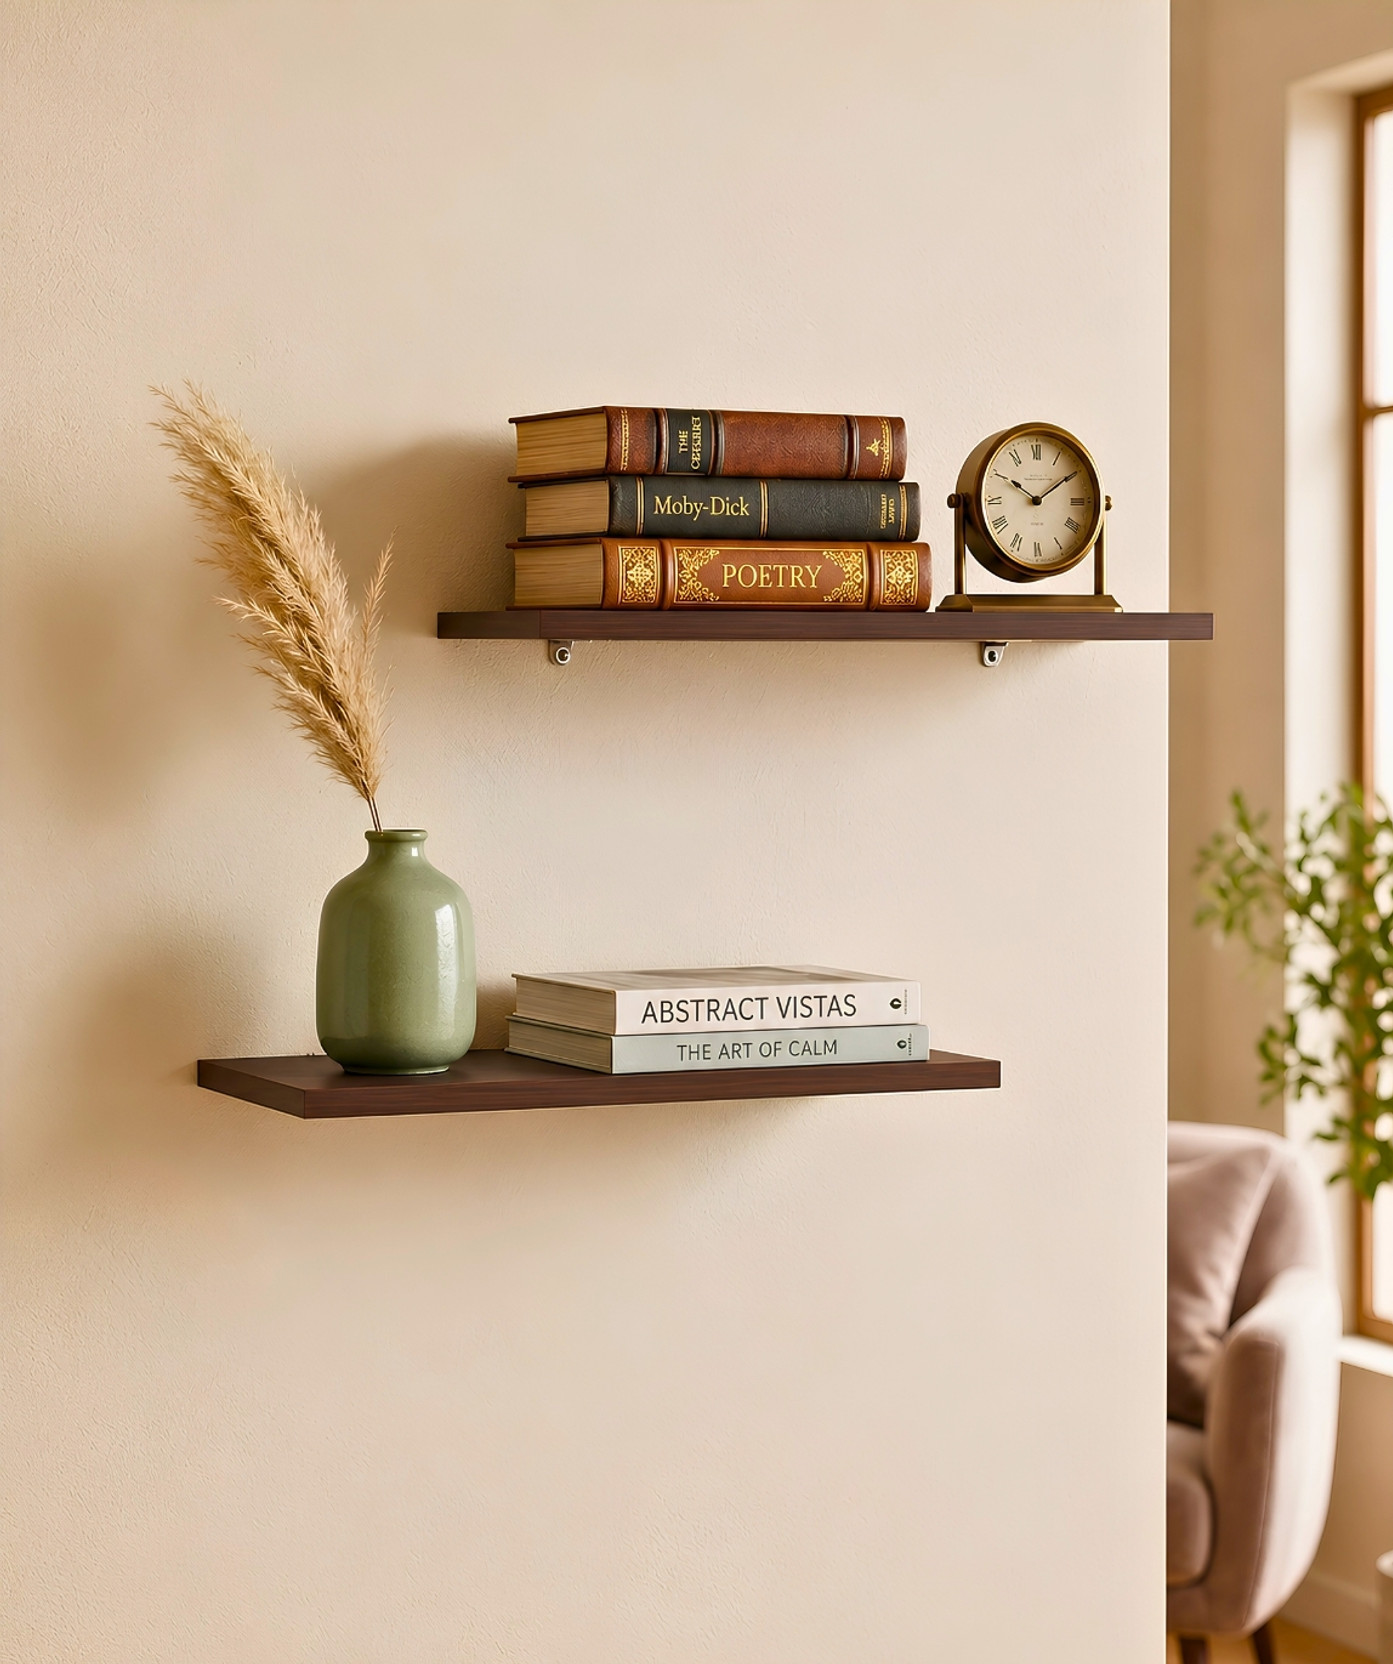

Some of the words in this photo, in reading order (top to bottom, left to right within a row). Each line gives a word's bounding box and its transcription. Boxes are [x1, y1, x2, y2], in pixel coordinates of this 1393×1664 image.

[653, 495, 750, 521] Moby-Dick
[722, 563, 823, 589] POETRY
[641, 997, 769, 1024] ABSTRACT
[776, 994, 857, 1019] VISTAS
[676, 1043, 712, 1062] THE
[718, 1042, 753, 1060] ART
[758, 1041, 782, 1058] OF
[788, 1039, 838, 1056] CALM
